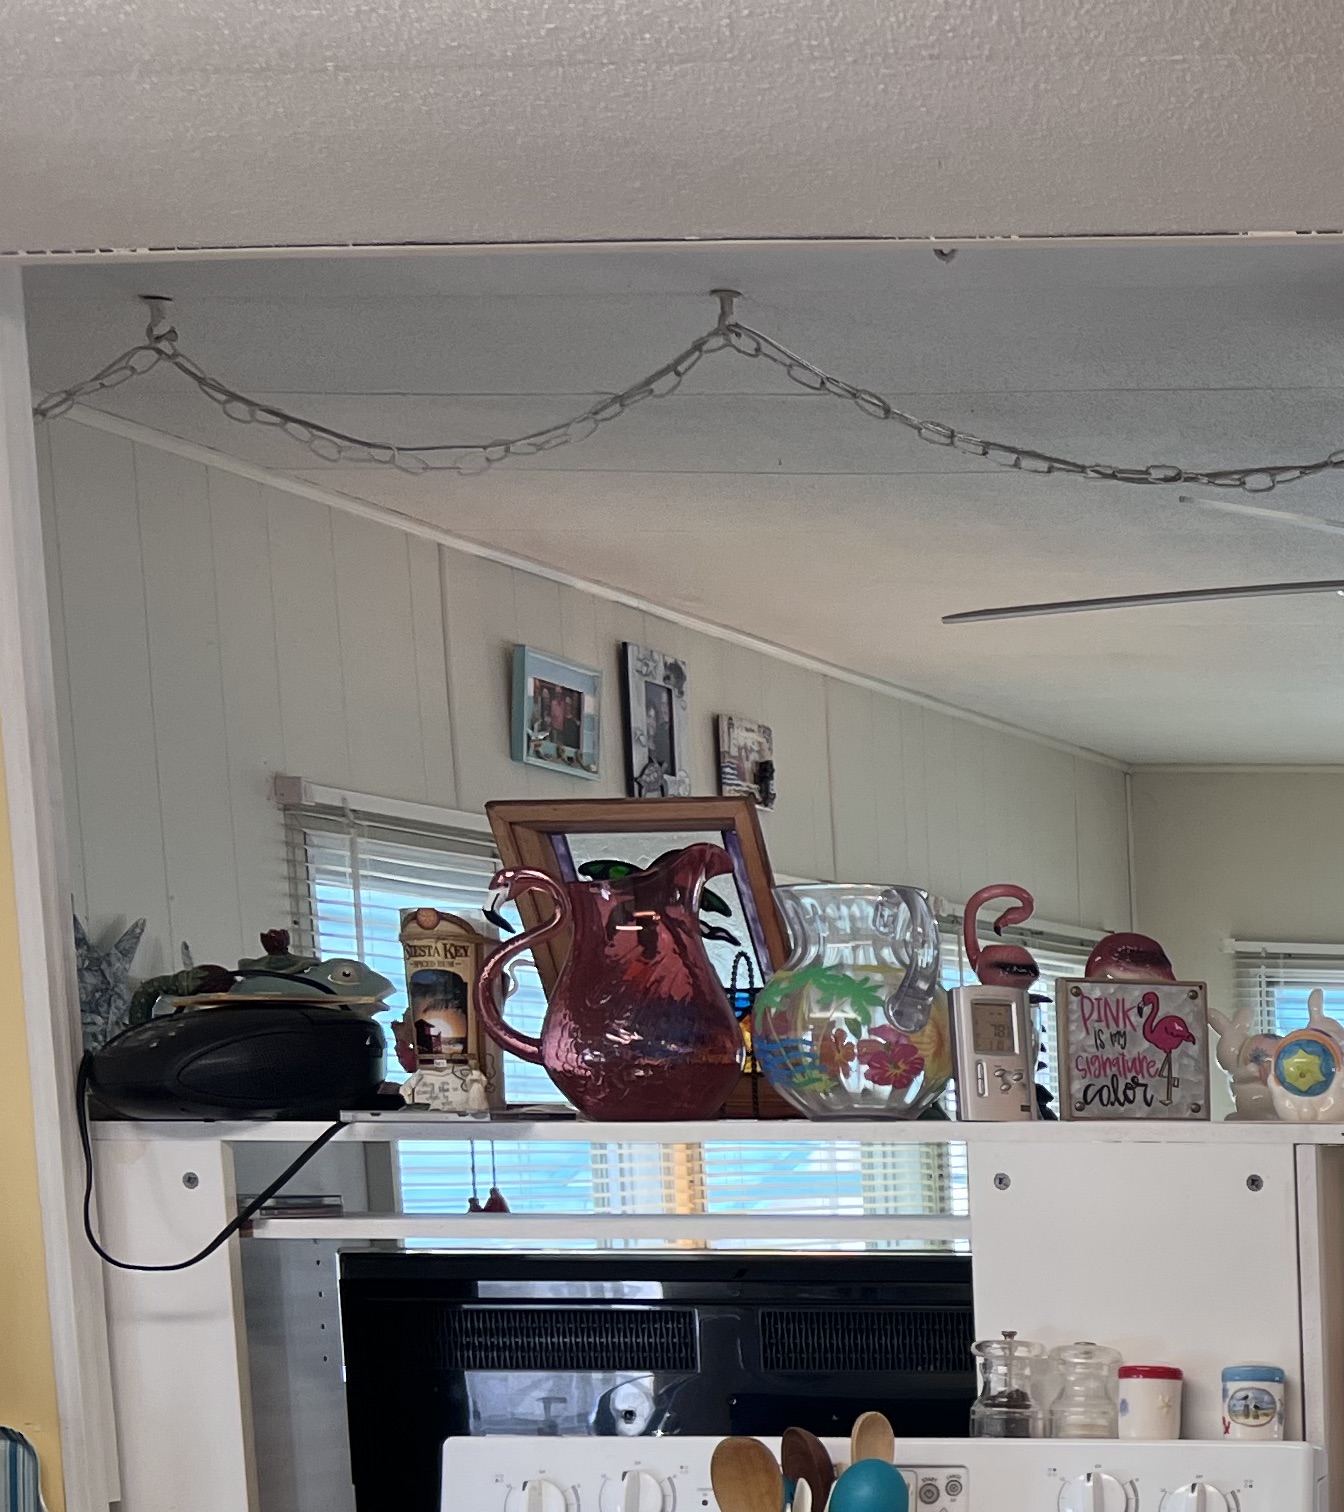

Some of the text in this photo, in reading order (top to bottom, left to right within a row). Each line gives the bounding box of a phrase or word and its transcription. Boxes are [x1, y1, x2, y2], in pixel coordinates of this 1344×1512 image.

[442, 942, 470, 960] KEY
[1080, 991, 1137, 1036] PINK
[1109, 1030, 1127, 1050] my
[1082, 1073, 1154, 1107] color
